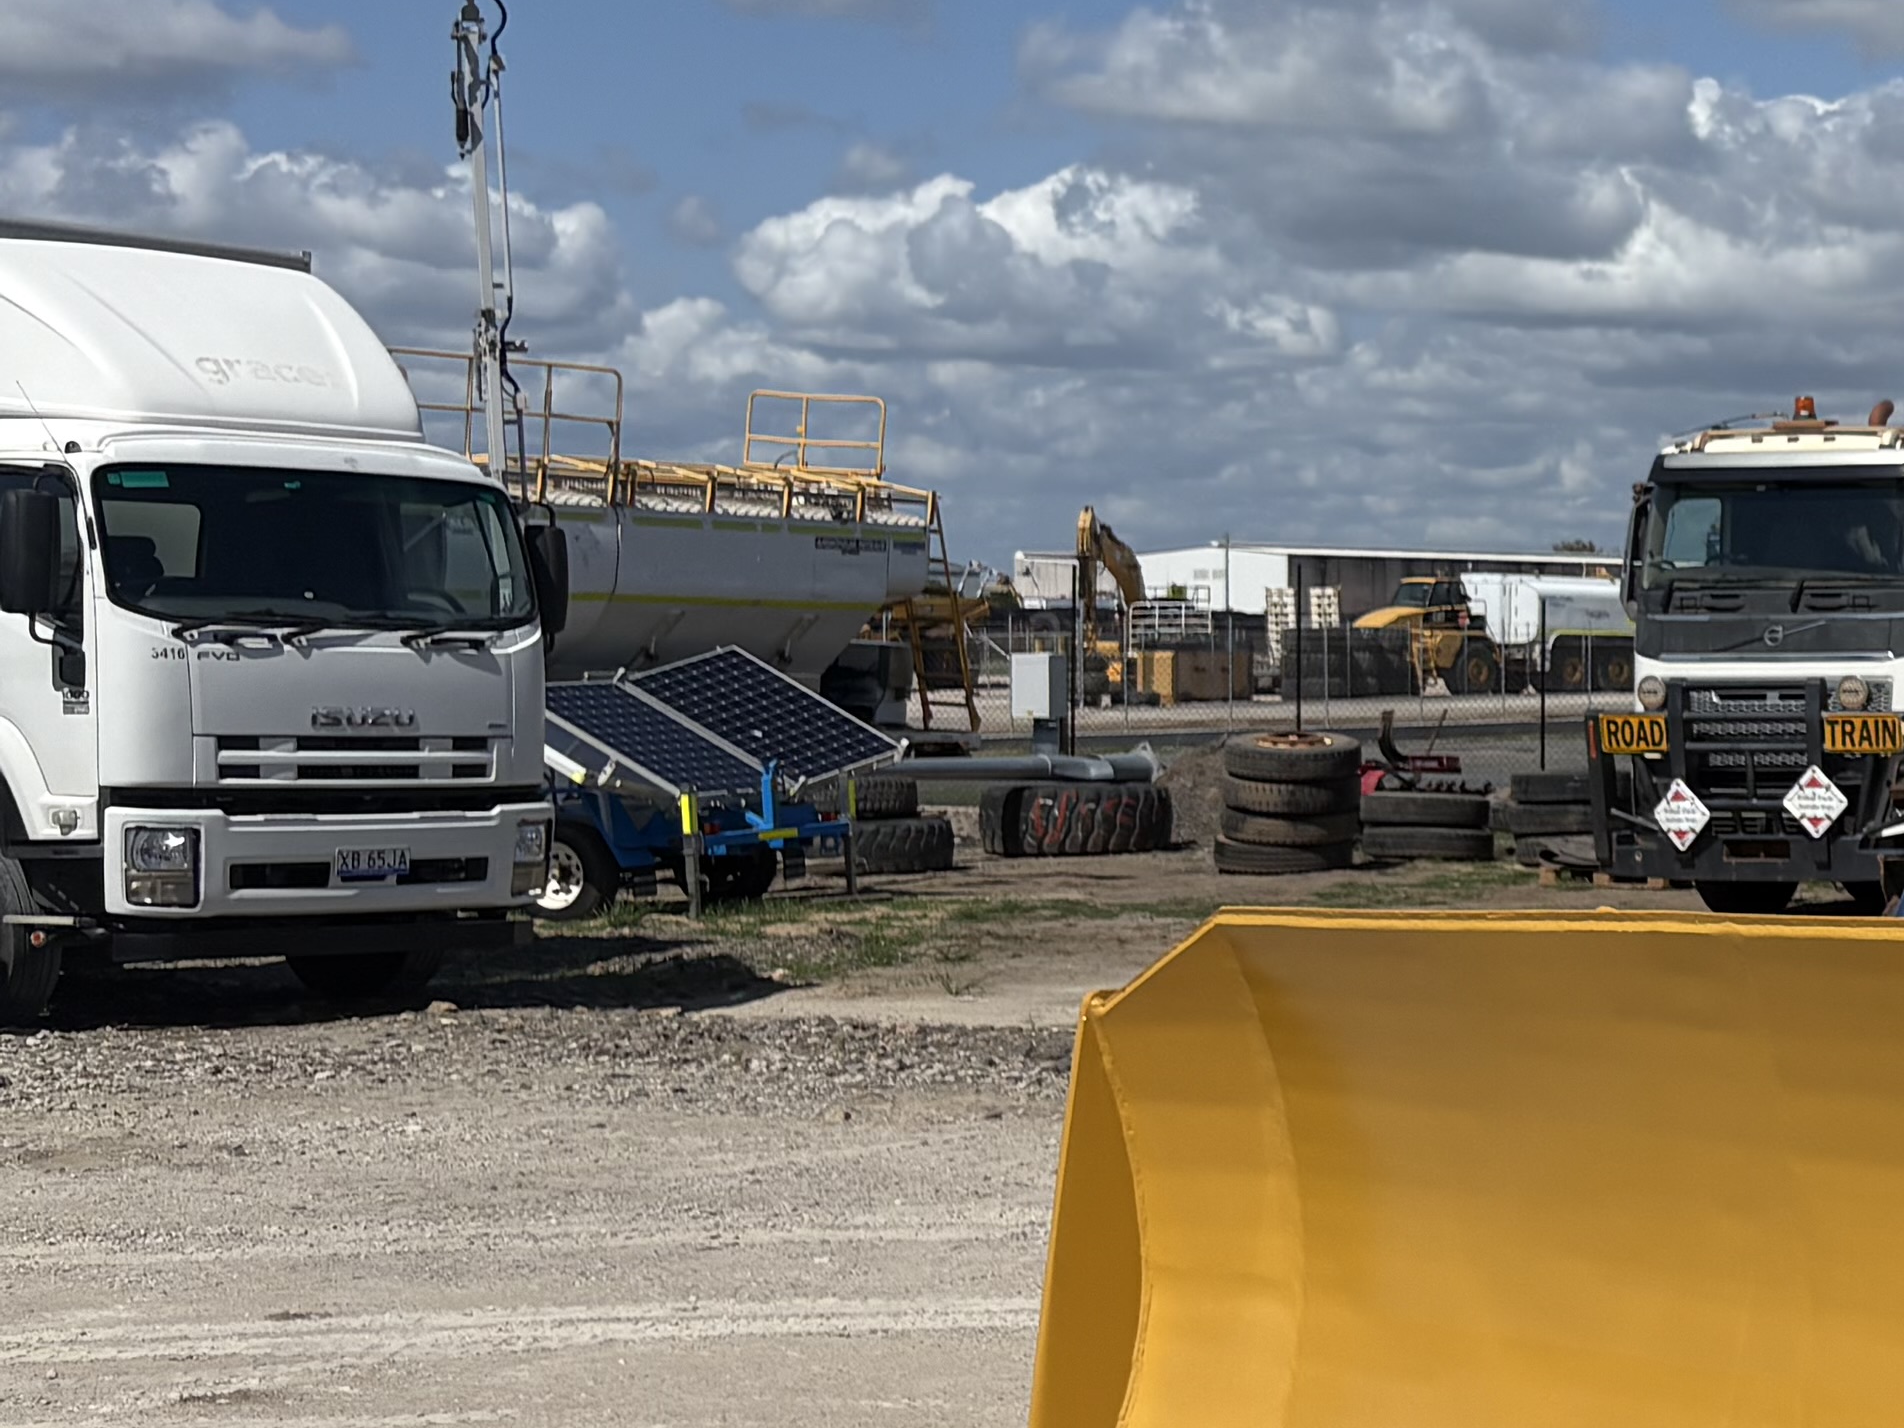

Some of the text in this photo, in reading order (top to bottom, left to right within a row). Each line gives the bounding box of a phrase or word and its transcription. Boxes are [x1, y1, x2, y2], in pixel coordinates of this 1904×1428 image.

[311, 707, 415, 728] ISUZU
[1606, 717, 1664, 748] ROAD
[1826, 719, 1898, 749] TRAIN
